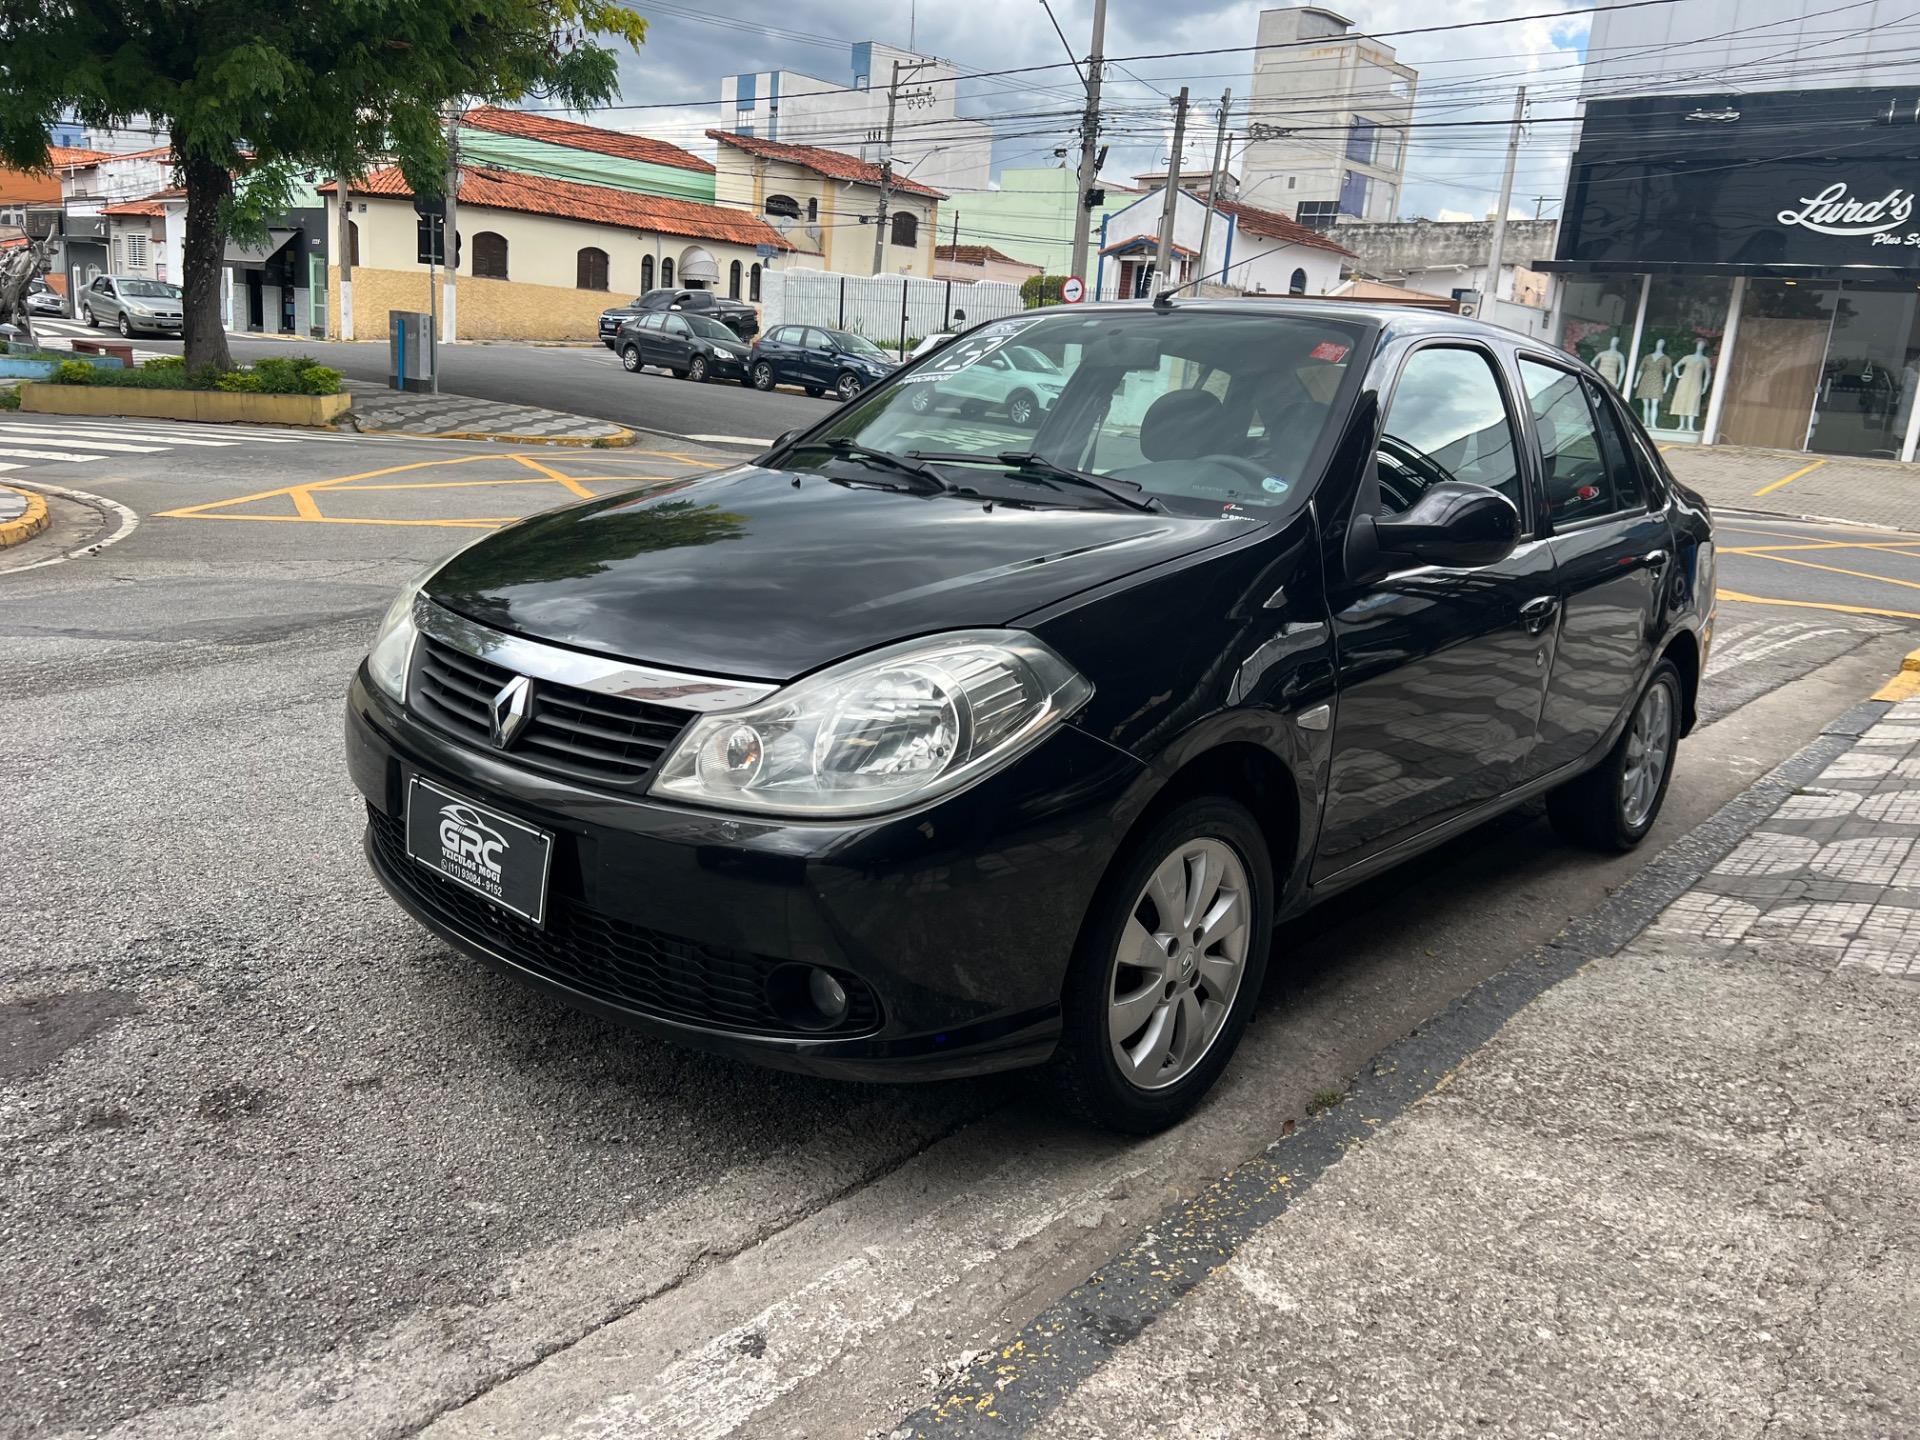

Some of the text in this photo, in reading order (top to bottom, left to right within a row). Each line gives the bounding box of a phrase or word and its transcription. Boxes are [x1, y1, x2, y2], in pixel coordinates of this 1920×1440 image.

[1777, 182, 1915, 235] Lurd's
[1871, 232, 1902, 246] Plus
[440, 819, 503, 875] GRC
[442, 846, 501, 884] VEICULOS MOGI
[448, 861, 461, 878] (11)
